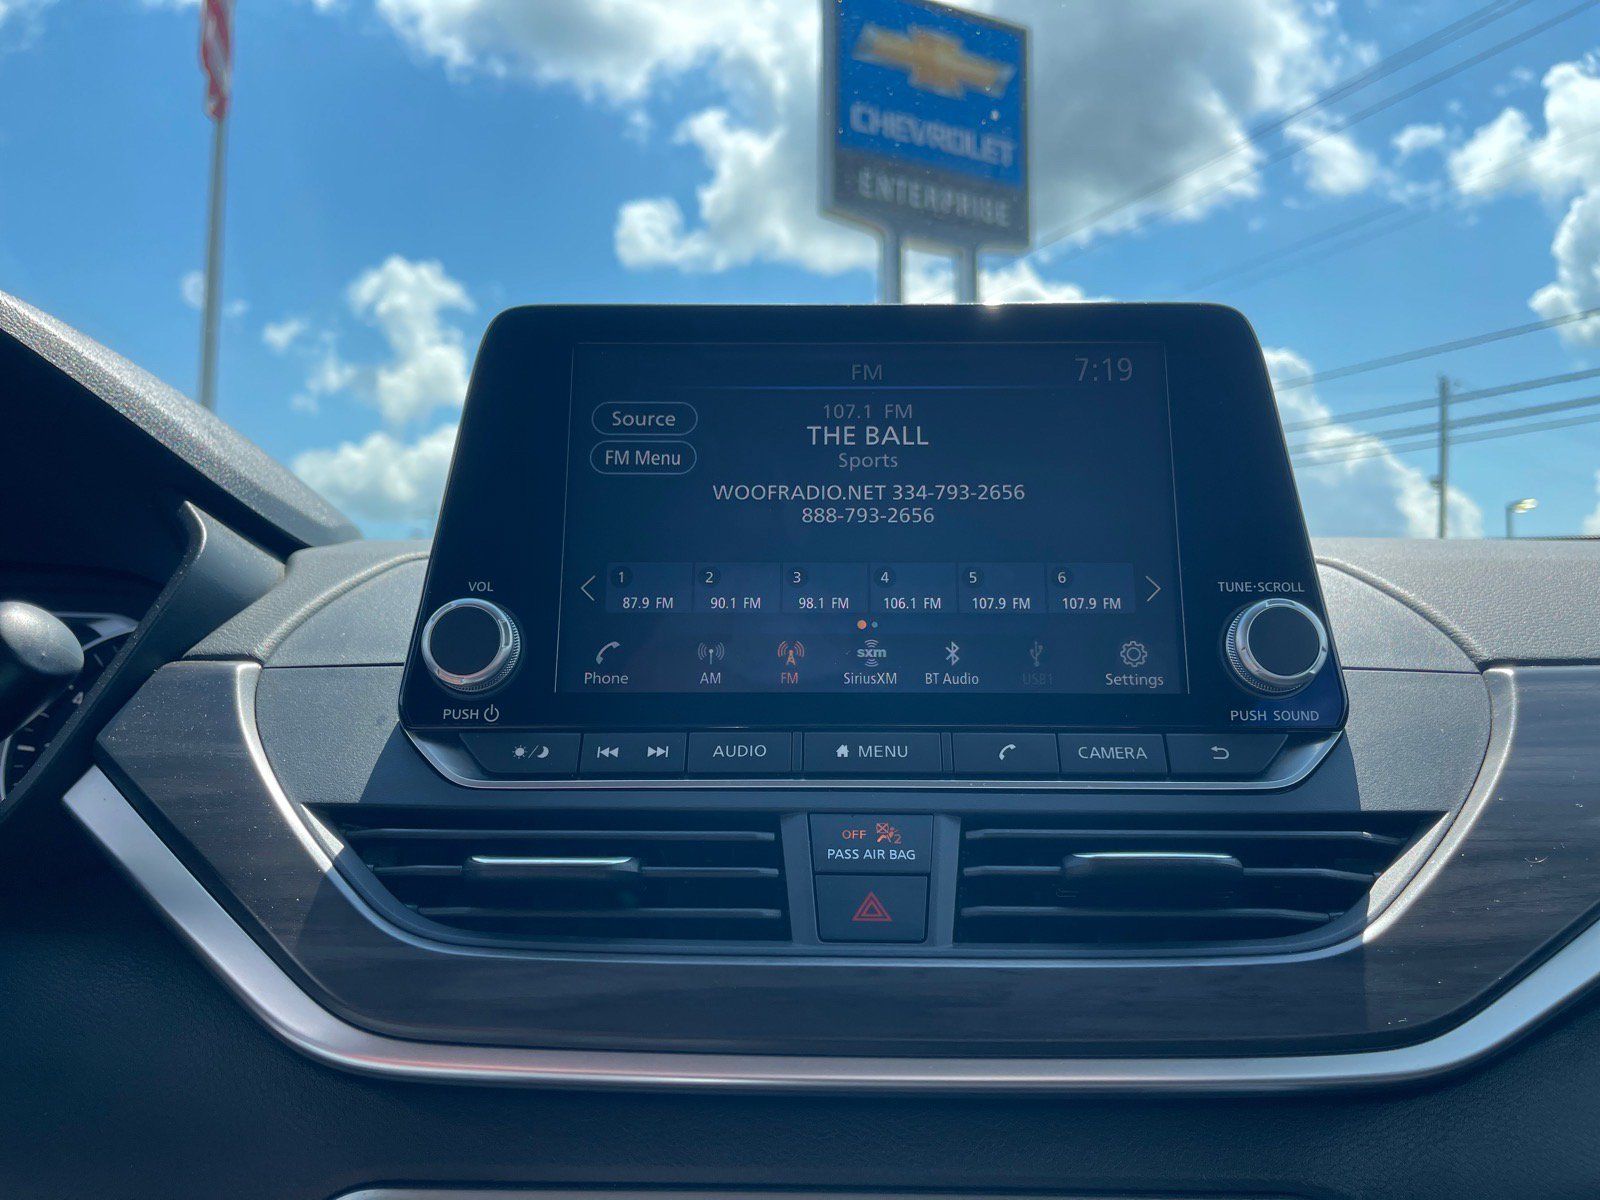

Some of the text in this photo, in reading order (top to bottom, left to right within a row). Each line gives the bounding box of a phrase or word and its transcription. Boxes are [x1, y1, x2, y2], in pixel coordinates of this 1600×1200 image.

[850, 101, 1015, 168] CHEVROLET
[852, 364, 883, 381] FM
[1075, 357, 1133, 382] 7:19
[824, 404, 913, 419] 107.1 FM
[612, 411, 676, 427] Source
[807, 425, 929, 446] THE BALL
[605, 450, 681, 466] FM Menu
[838, 453, 898, 471] Sports
[713, 484, 1025, 501] WOOFRADIO.NET 334-793-2656
[802, 507, 934, 524] 888-793-2656
[618, 571, 625, 583] 1
[705, 571, 714, 583] 2
[793, 571, 801, 583] 3
[880, 571, 890, 583] 4
[969, 571, 977, 583] 5
[1058, 571, 1066, 583] 6
[468, 581, 494, 592] VOL
[622, 597, 674, 610] 87.9 FM
[710, 597, 761, 610] 90.1 FM
[798, 597, 849, 610] 98.1 FM
[884, 597, 942, 610] 106.1 FM
[972, 597, 1031, 610] 107.9 FM
[1062, 597, 1122, 610] 107.9 FM
[584, 672, 629, 685] Phone
[700, 672, 721, 685] AM
[780, 672, 798, 685] FM
[843, 672, 897, 685] SiriusXM
[925, 672, 979, 685] BT Audio
[1106, 673, 1164, 688] Settings
[443, 709, 479, 720] PUSH
[1230, 710, 1320, 722] PUSH SOUND
[712, 744, 767, 758] AUDIO
[858, 745, 908, 758] MENU
[1078, 746, 1148, 760] CAMERA
[842, 829, 867, 840] OFF
[828, 848, 916, 860] PASS AIR BAG
